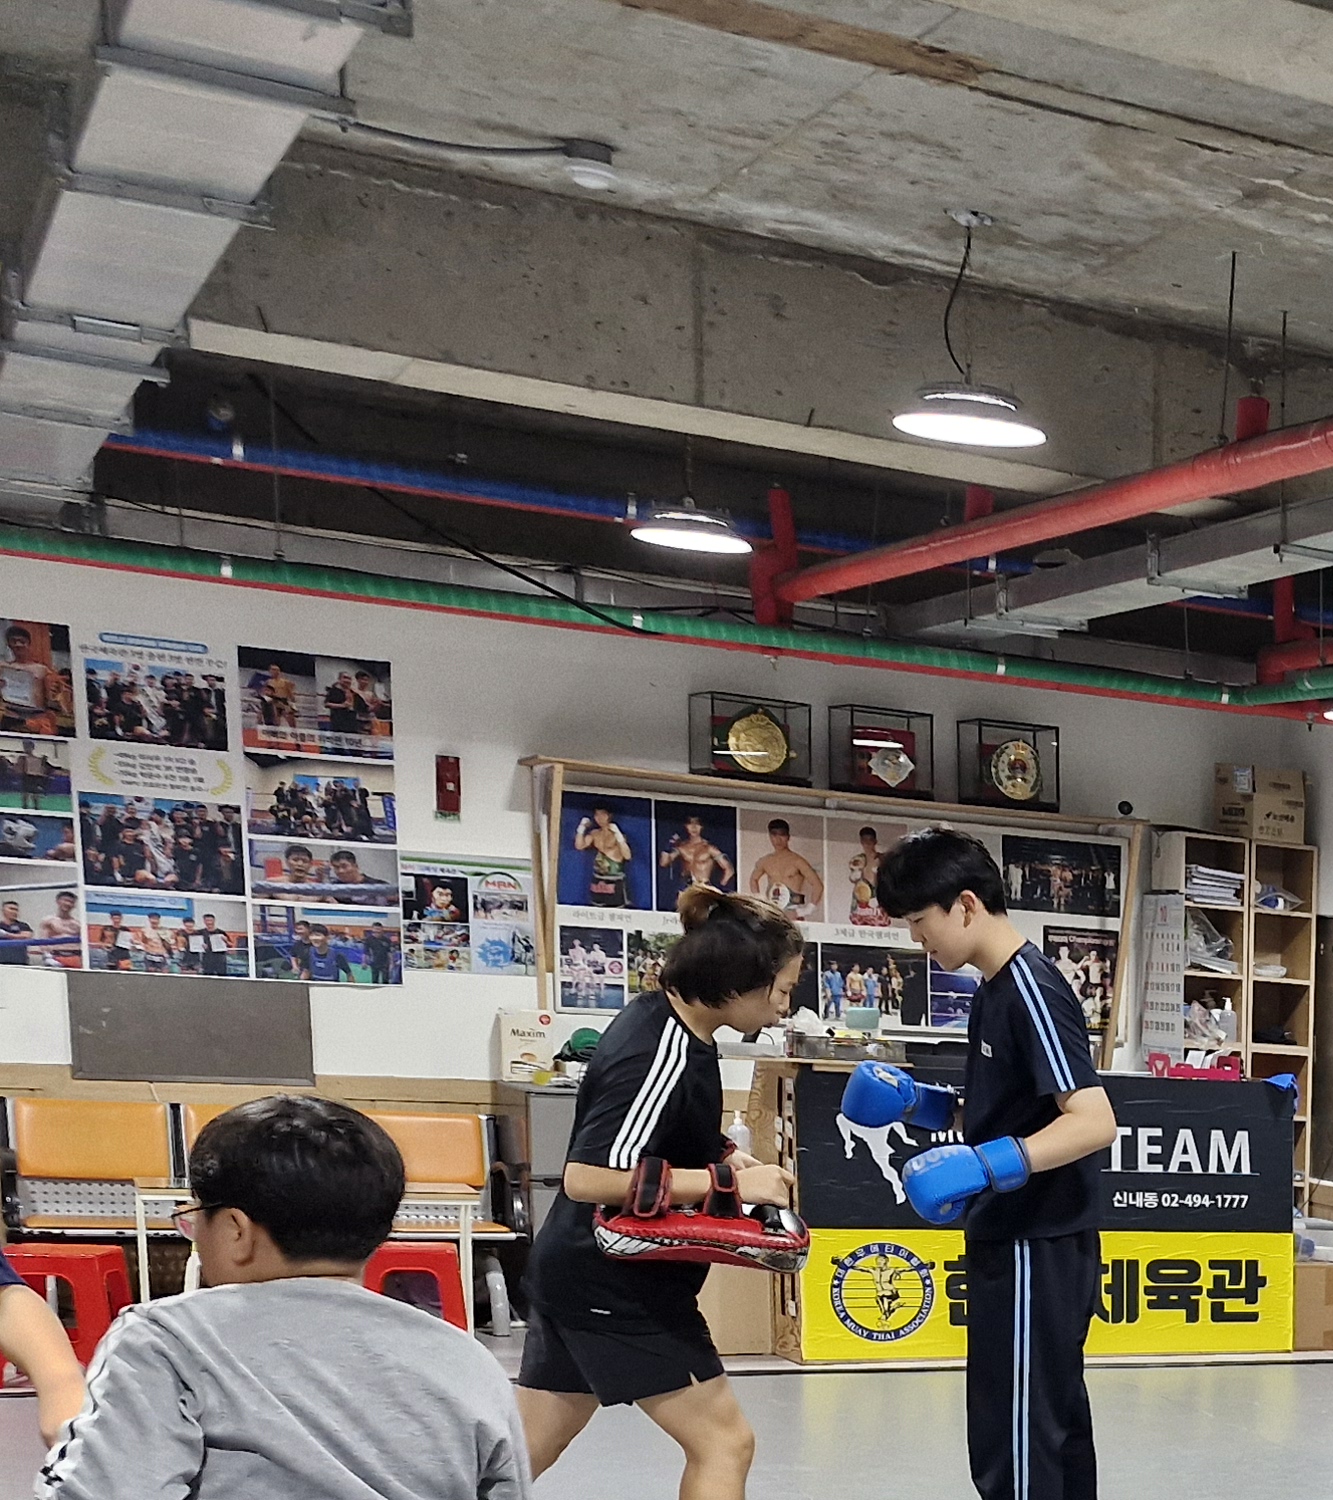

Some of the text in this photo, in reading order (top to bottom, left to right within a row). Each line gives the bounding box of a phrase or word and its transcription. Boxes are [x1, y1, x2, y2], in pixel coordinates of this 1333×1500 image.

[510, 1028, 546, 1038] Maxim
[1111, 1127, 1251, 1174] TEAM
[1113, 1191, 1249, 1209] 신내동 02-494-1777
[832, 1287, 932, 1341] KOREA MUAY THAI ASSOCIATION
